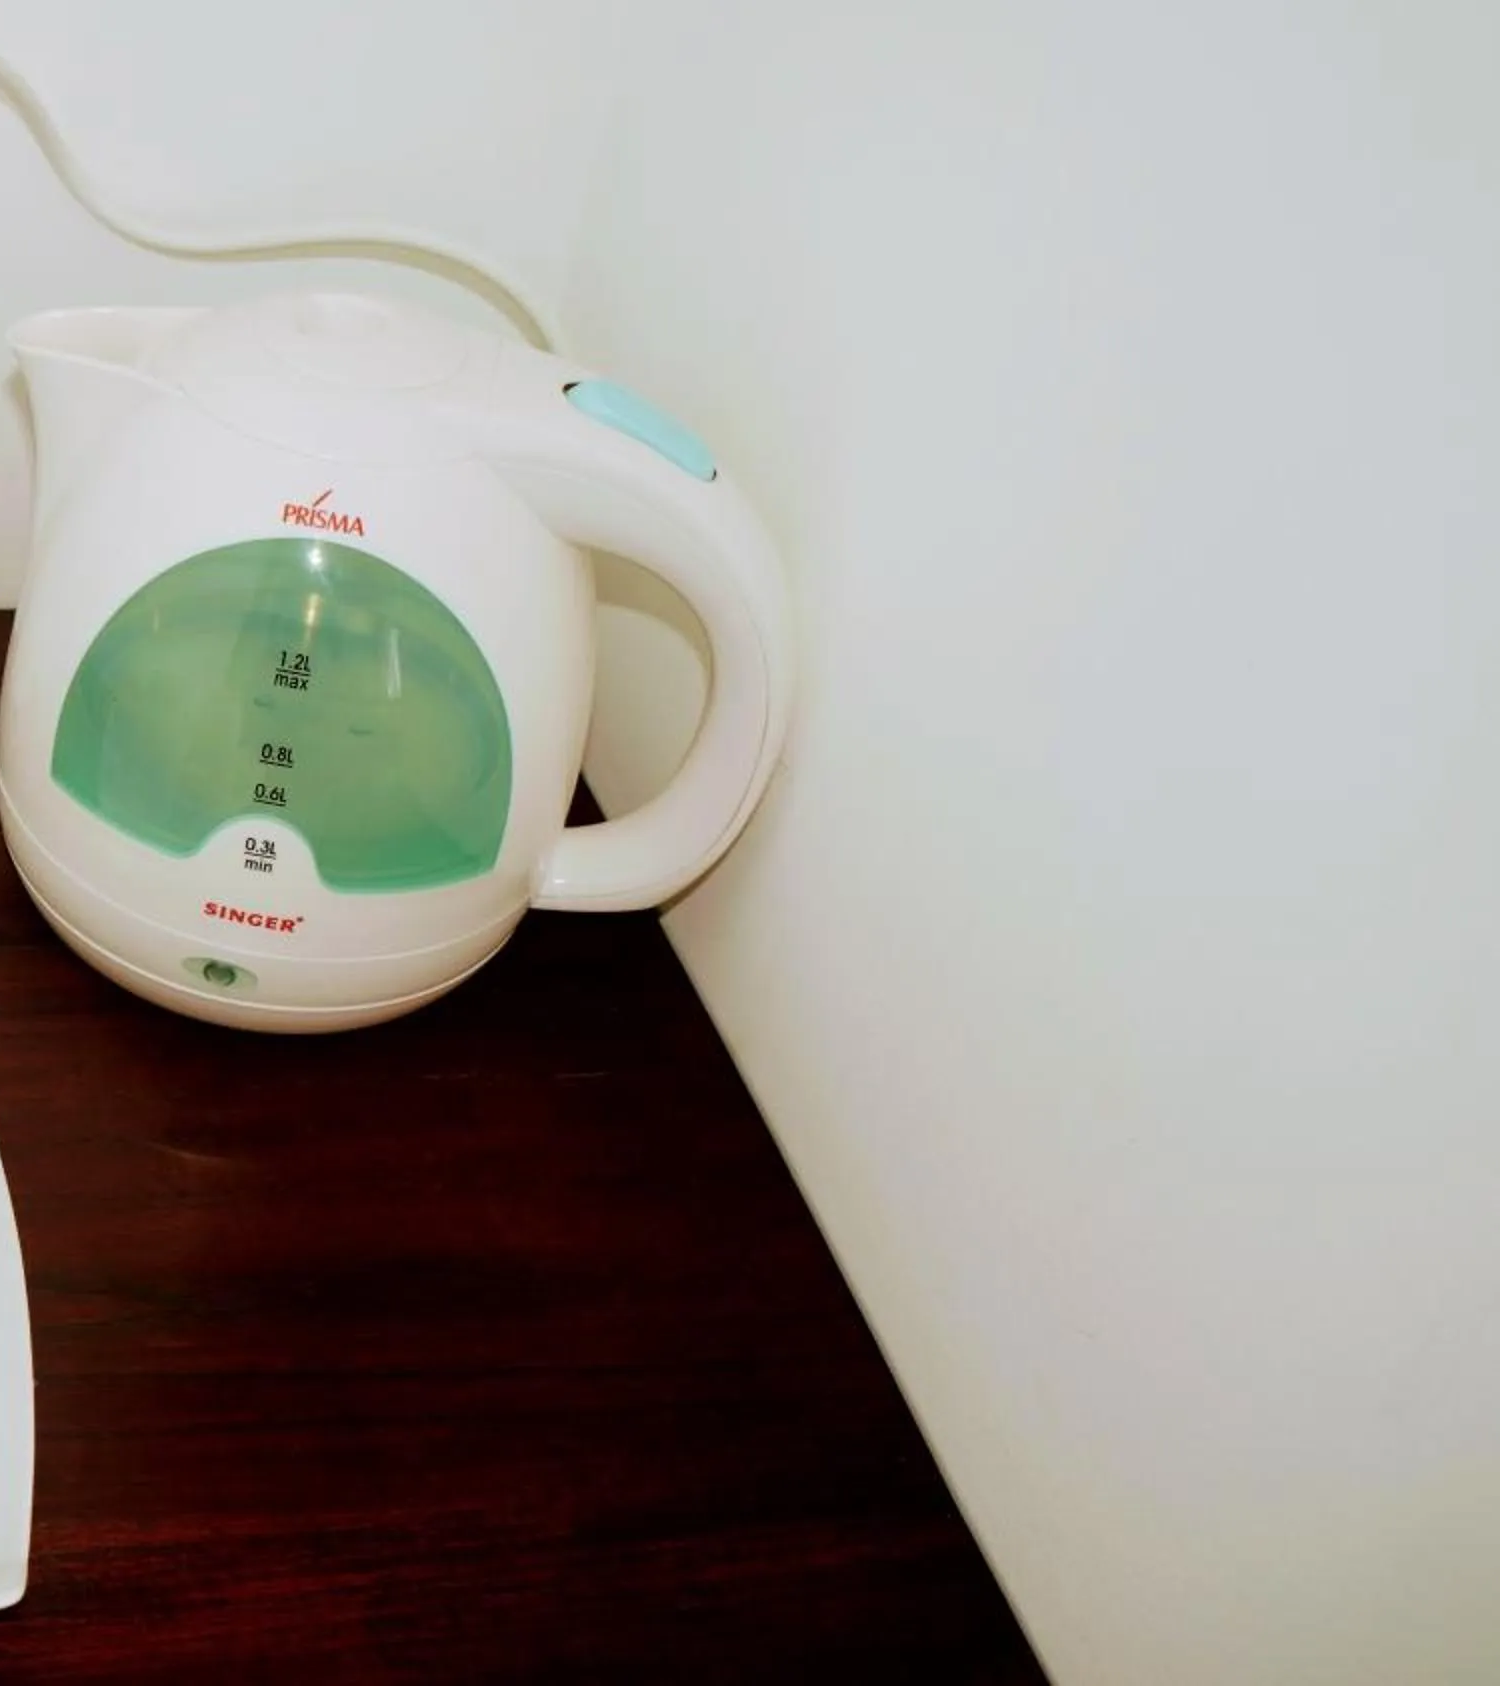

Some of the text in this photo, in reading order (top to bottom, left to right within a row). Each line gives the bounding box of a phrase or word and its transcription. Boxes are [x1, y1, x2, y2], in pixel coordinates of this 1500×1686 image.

[282, 490, 365, 537] PRISMA
[278, 651, 311, 673] 1.2L
[273, 673, 310, 691] max
[260, 743, 294, 764] 0.8L
[254, 783, 287, 803] 0.6L
[244, 837, 276, 855] 0.3L
[244, 858, 273, 873] min
[203, 902, 297, 933] SINGER
